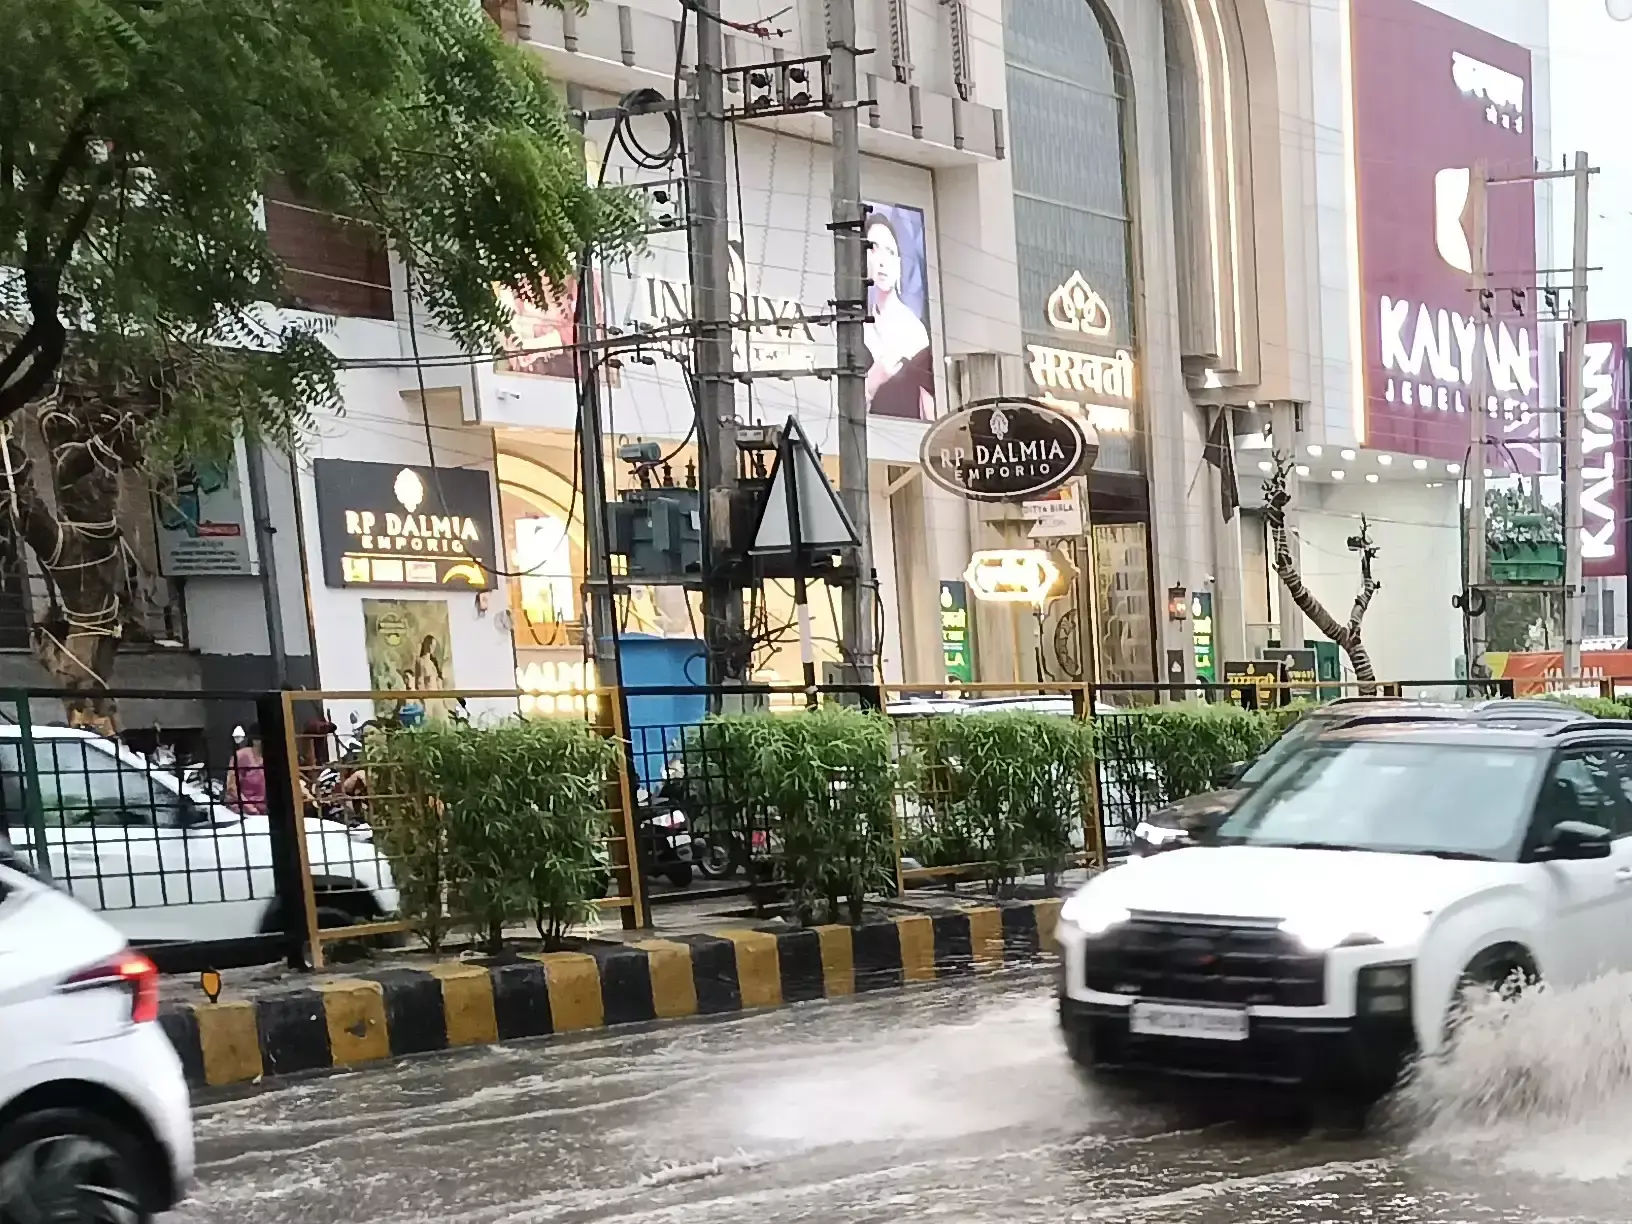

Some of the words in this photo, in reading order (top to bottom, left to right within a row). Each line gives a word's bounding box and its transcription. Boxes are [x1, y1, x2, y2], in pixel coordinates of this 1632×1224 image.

[646, 277, 816, 342] INRIYA
[1385, 378, 1530, 422] JEWELERS
[940, 447, 965, 469] RP
[976, 438, 1065, 465] DALMIA
[1580, 342, 1615, 558] KALYAN
[954, 463, 1050, 481] EMPORIO
[345, 510, 375, 534] RP
[385, 512, 479, 541] DALMIA
[361, 535, 464, 553] EMPORIO
